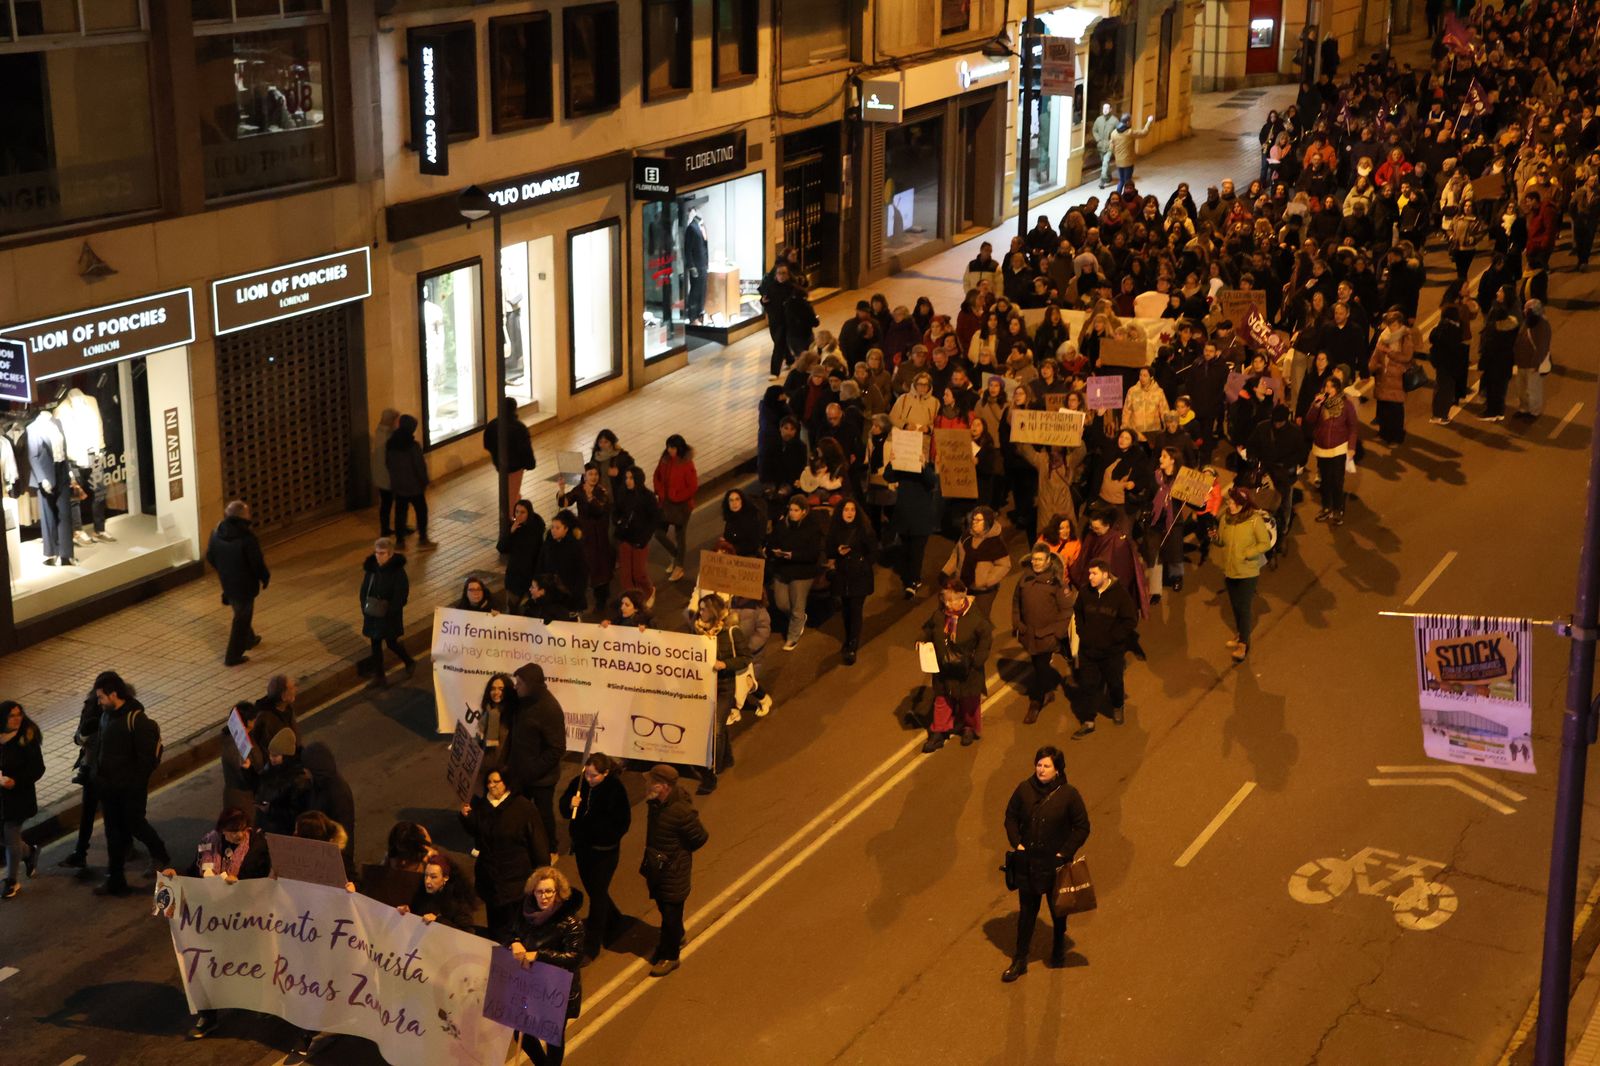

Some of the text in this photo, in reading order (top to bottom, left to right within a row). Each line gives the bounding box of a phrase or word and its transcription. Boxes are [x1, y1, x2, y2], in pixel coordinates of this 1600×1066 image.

[422, 46, 437, 164] ADOLFO DOMINGUEZ
[685, 145, 734, 172] FLORENTINO
[521, 171, 581, 200] DOMINGUEZ
[635, 183, 670, 193] FLORENTINO
[235, 264, 348, 304] LION OF PORCHES
[279, 292, 310, 308] LONDON
[30, 308, 167, 353] LION OF PORCHES
[83, 339, 120, 358] LONDON
[0, 361, 11, 369] OF
[0, 371, 25, 383] RCHES
[166, 410, 178, 430] IN
[167, 435, 181, 475] NEW
[441, 621, 707, 663] Sin feminismo no hay cambio social
[1435, 638, 1504, 667] STOCK
[442, 642, 703, 681] No hay cambio social sin TRABAJO SOCIAL
[607, 683, 707, 700] #SinFeminismoNoHayIgualdad
[180, 903, 429, 984] Movimiento Feminista
[182, 947, 427, 1037] Trece Rosas Zamora
